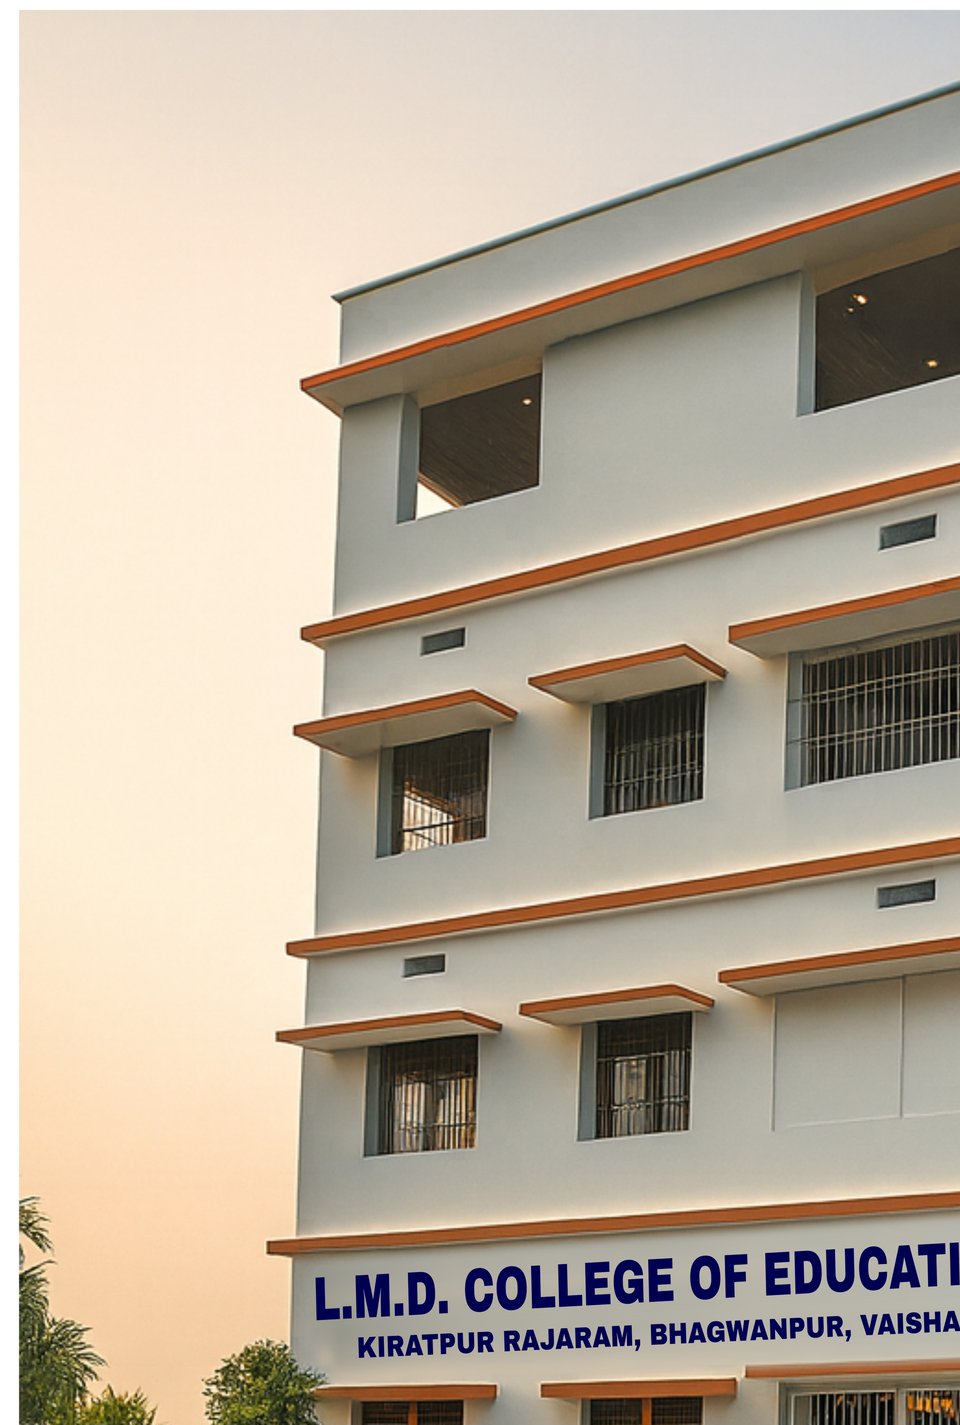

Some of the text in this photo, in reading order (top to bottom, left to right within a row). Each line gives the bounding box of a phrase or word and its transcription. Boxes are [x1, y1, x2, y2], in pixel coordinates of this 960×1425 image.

[314, 1271, 449, 1321] L.M.D.
[464, 1257, 675, 1313] COLLEGE
[689, 1253, 748, 1301] OF
[357, 1331, 495, 1359] KIRATPUR
[503, 1324, 642, 1353] RAJARAM,
[650, 1313, 852, 1346] BHAGWANPUR,
